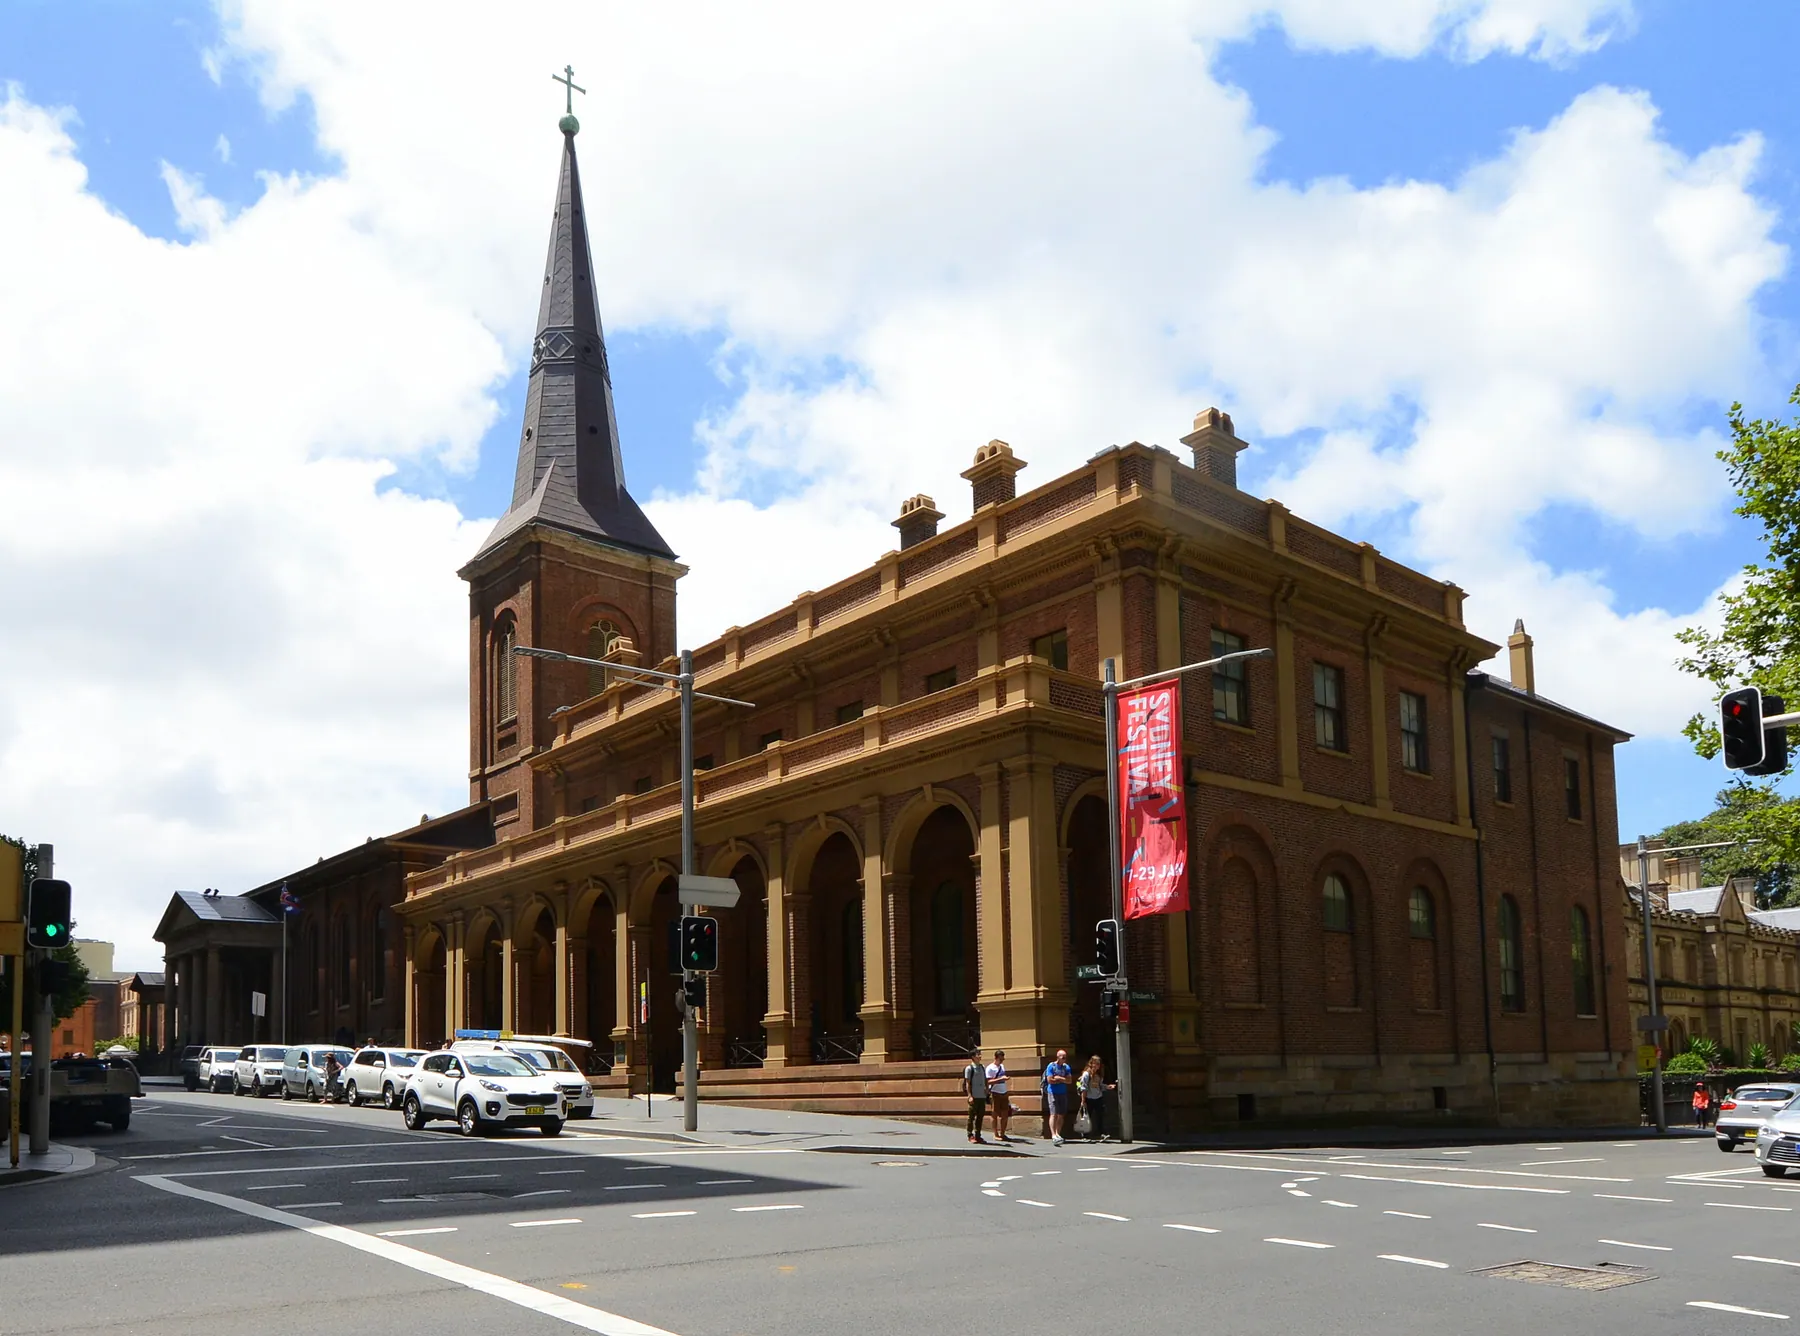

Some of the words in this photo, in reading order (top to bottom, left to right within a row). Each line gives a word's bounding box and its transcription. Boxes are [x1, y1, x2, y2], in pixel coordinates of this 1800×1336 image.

[1127, 697, 1149, 810] FESTIVAL
[1149, 692, 1172, 789] SYDNEY
[1156, 891, 1179, 900] STAR
[1158, 862, 1183, 878] JAN
